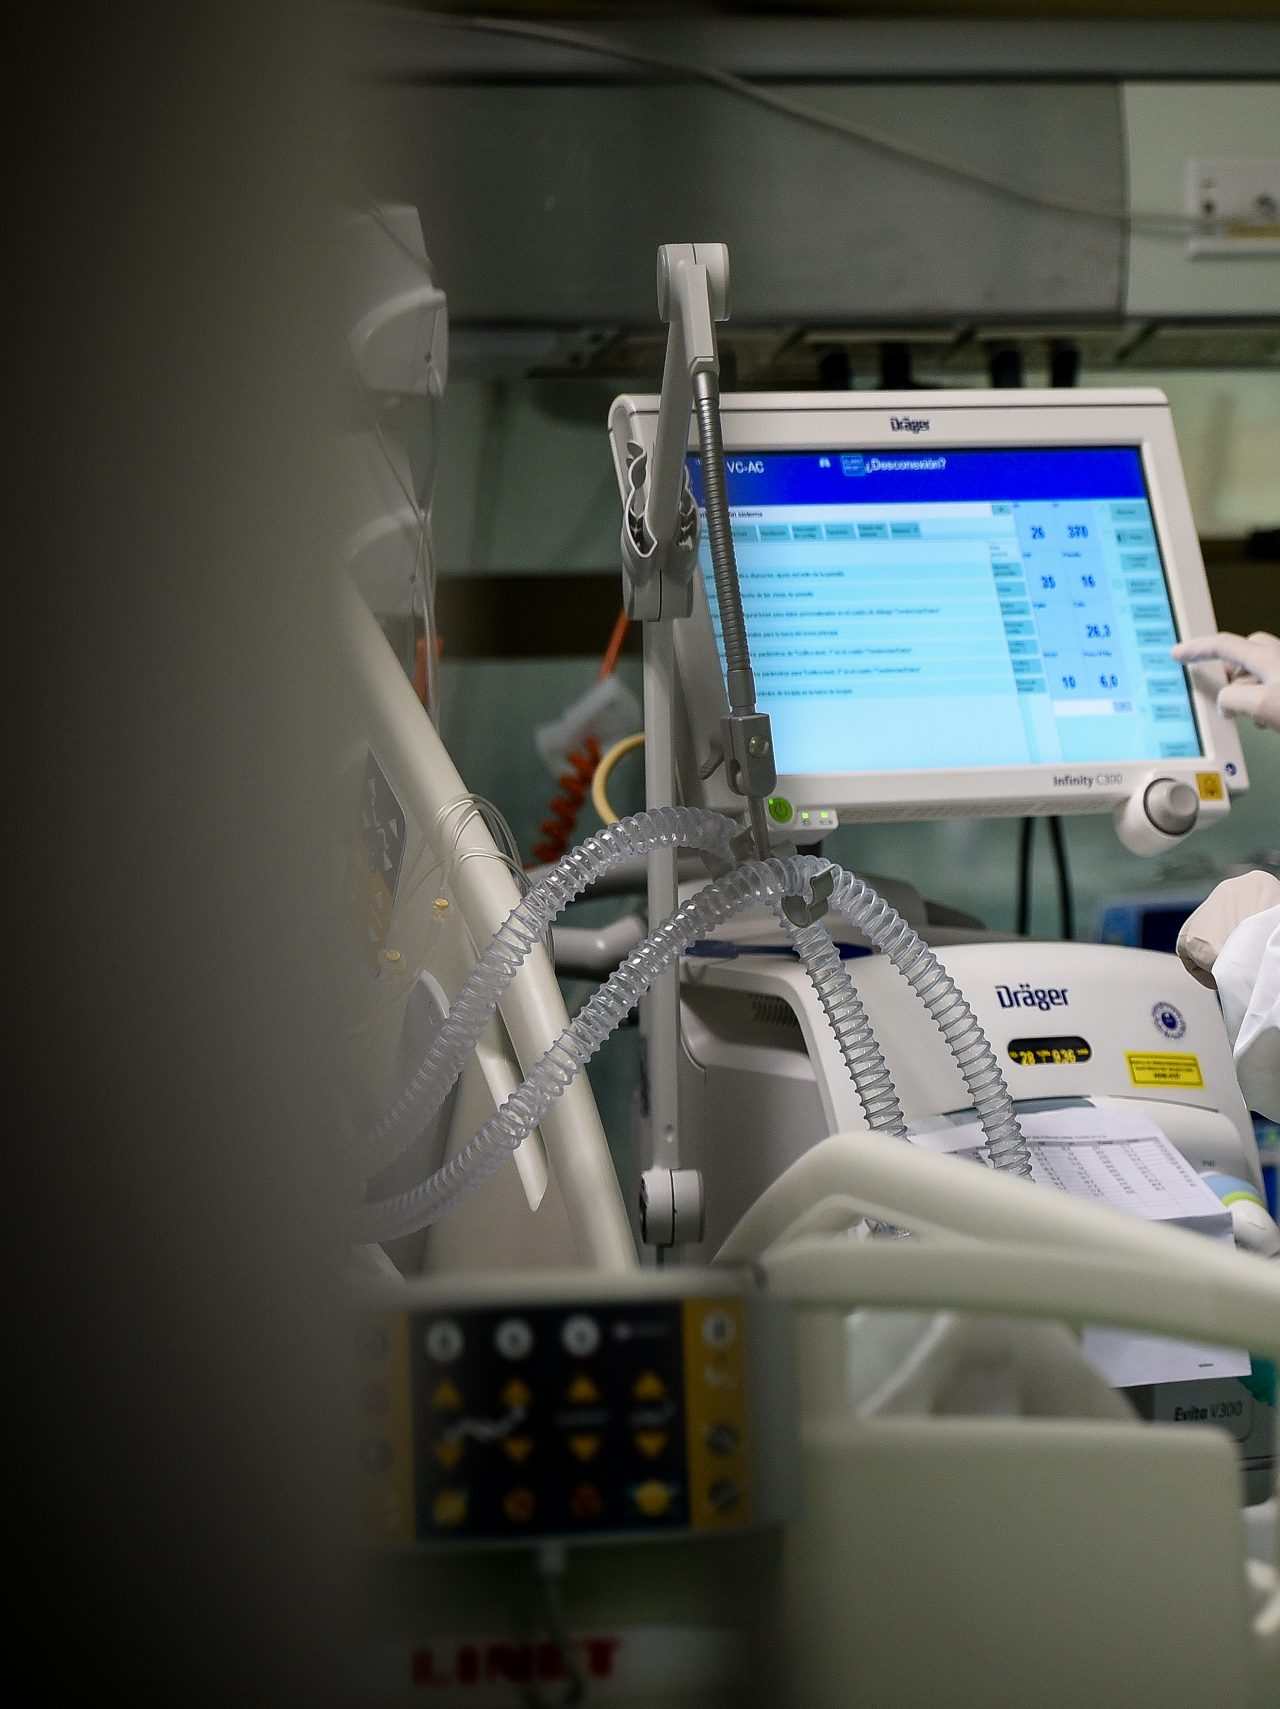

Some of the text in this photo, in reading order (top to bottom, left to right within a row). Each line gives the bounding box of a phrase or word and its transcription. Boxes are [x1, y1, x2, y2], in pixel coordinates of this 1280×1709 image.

[890, 416, 930, 434] Dräger
[726, 460, 765, 474] VC-AC
[1054, 773, 1123, 788] Infinity C300
[995, 983, 1070, 1011] Dräger
[1173, 1405, 1208, 1422] Evita
